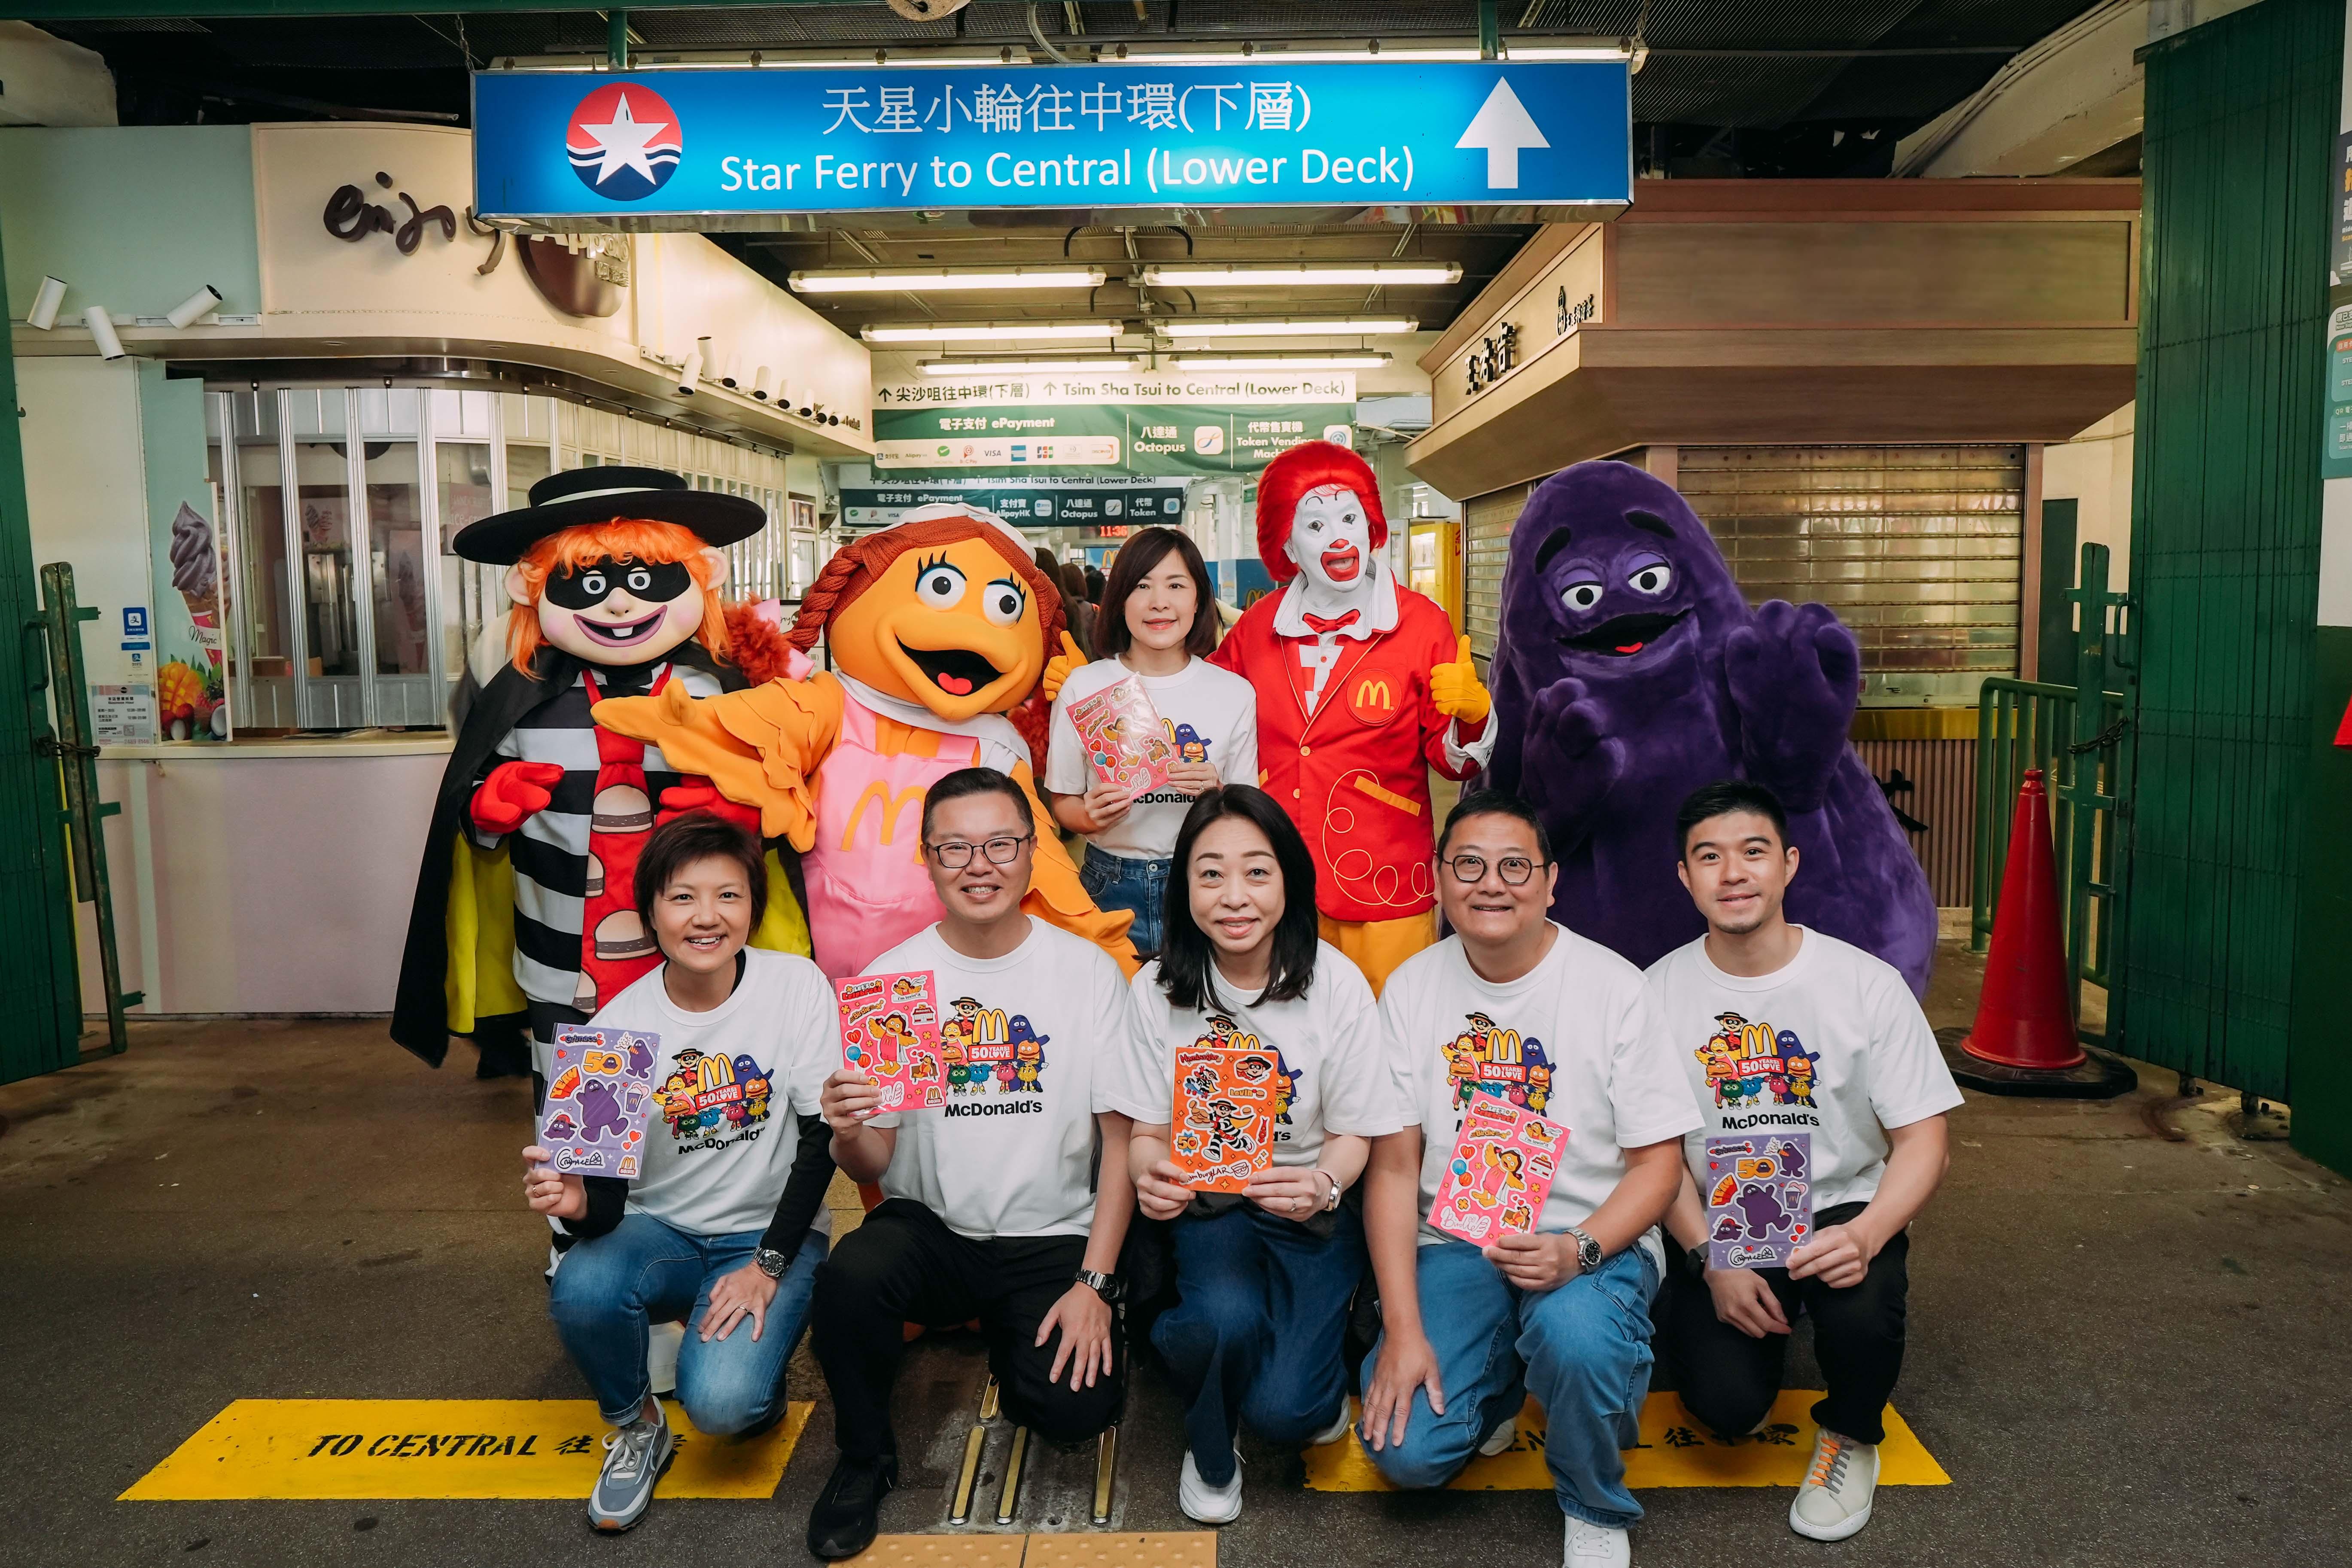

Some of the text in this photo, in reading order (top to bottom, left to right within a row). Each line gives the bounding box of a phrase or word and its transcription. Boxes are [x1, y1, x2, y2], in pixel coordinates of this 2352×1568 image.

[821, 81, 1311, 135] 天星小輪往中環(下層)
[722, 145, 1414, 197] Star Ferry to Central (Lower Deck)
[897, 383, 1029, 402] 尖沙咀往中環(下層)
[1063, 381, 1345, 397] Tsim Sha Tsui to Central (Lower Deck)
[939, 417, 987, 430] 電子支付
[992, 417, 1055, 431] ePayment
[1248, 421, 1303, 433] 代幣售賣機
[1141, 426, 1178, 439] 八達通
[1236, 436, 1268, 447] Token
[1134, 442, 1186, 455] Octopus
[1097, 477, 1128, 485] (Lower
[1132, 476, 1156, 484] Deck)
[877, 493, 911, 503] 電子支付
[917, 494, 963, 503] ePayment
[1000, 499, 1027, 508] 支付寶
[1065, 498, 1093, 508] 八達通
[1135, 498, 1153, 507] 代幣
[996, 510, 1031, 518] AlipayHK
[1061, 509, 1098, 520] Octopus
[1129, 508, 1156, 517] Token
[1100, 525, 1128, 537] 11:36
[189, 625, 217, 645] Magic
[853, 1006, 870, 1020] Birdie
[565, 1035, 597, 1044] Grimace
[971, 1047, 988, 1059] 50
[583, 1051, 623, 1075] 50
[1741, 1060, 1759, 1073] 50
[1483, 1065, 1501, 1078] 50
[716, 1087, 734, 1095] YEARS
[699, 1092, 716, 1107] 50
[944, 1100, 1043, 1117] McDonald's
[1722, 1113, 1820, 1130] McDonald's
[1177, 1135, 1199, 1150] 50
[1737, 1158, 1775, 1179] 50
[307, 1434, 363, 1457] TO
[367, 1434, 539, 1458] CENTRAL
